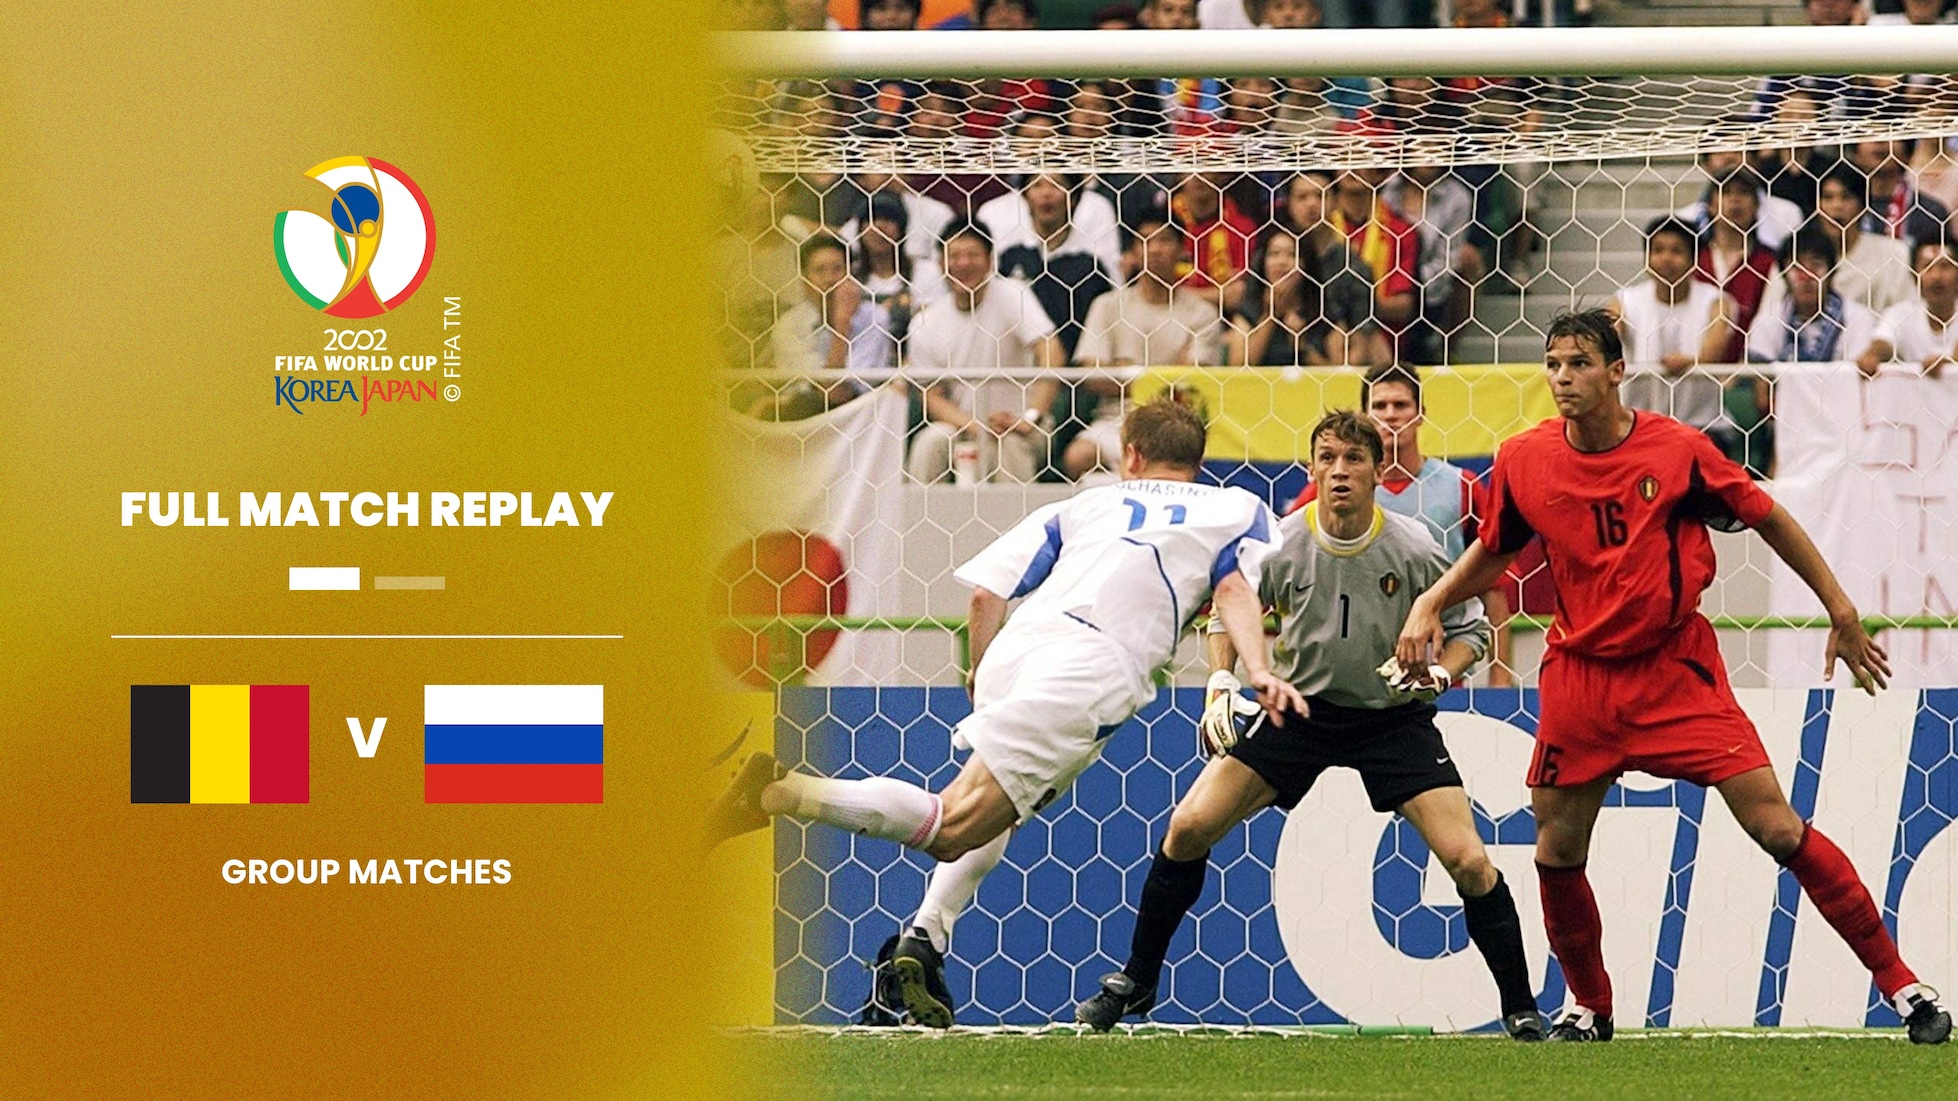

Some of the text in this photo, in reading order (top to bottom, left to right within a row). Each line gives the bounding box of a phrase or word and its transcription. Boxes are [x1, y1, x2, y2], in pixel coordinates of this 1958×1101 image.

[1122, 497, 1187, 532] 11
[1590, 500, 1629, 549] 16
[1339, 593, 1350, 639] 1
[1275, 689, 1958, 1028] Gill
